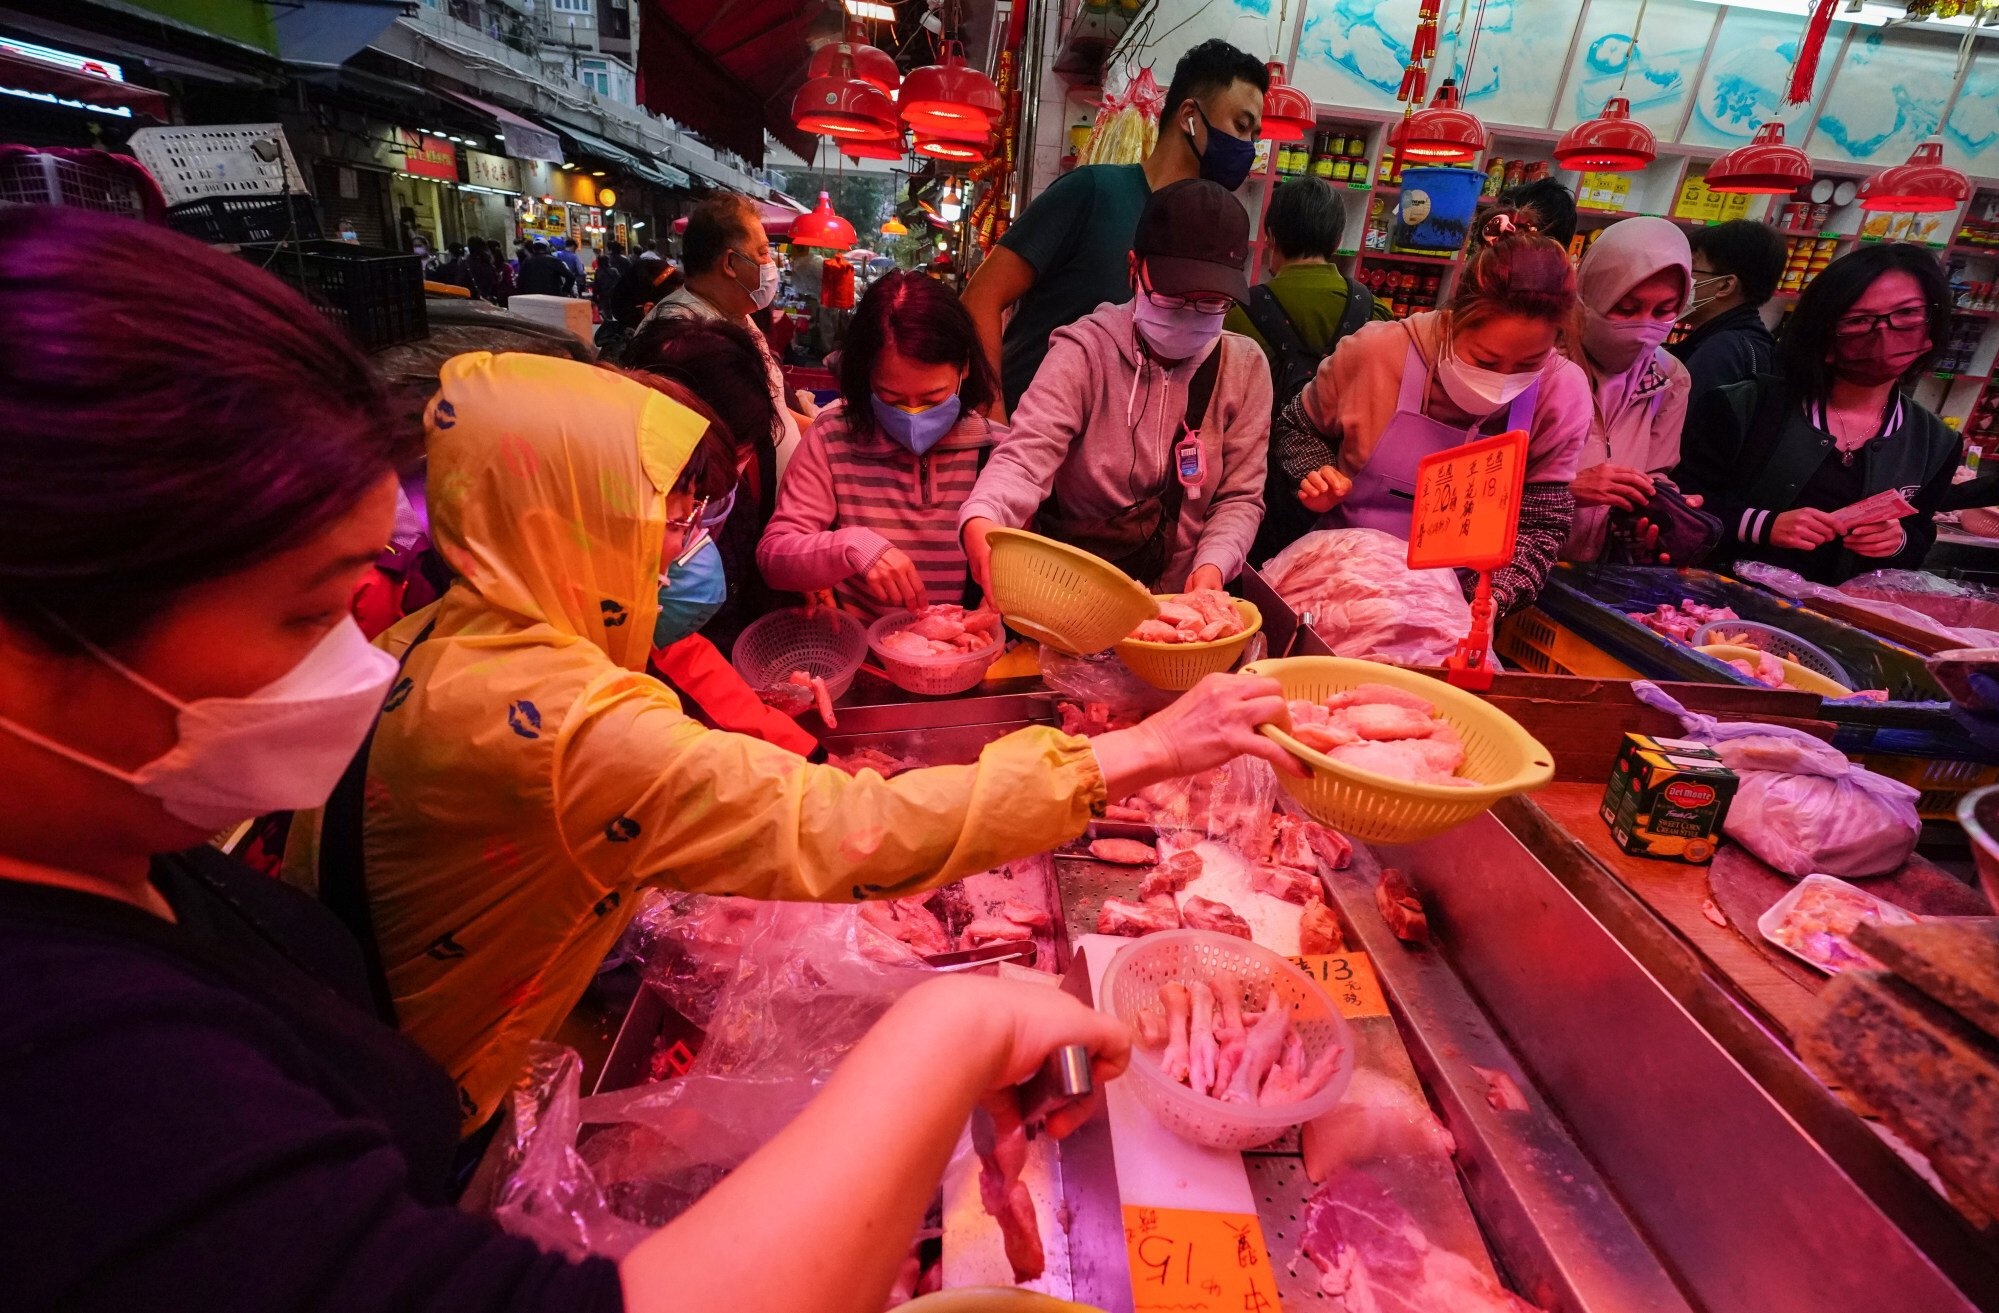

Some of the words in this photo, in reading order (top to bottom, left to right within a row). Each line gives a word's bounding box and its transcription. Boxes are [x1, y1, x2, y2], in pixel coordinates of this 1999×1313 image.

[1432, 484, 1451, 513] 20
[1482, 477, 1497, 499] 18
[1669, 787, 1683, 797] Del
[1683, 789, 1712, 801] Monte
[1322, 958, 1354, 981] 13
[1138, 1235, 1193, 1285] 15
